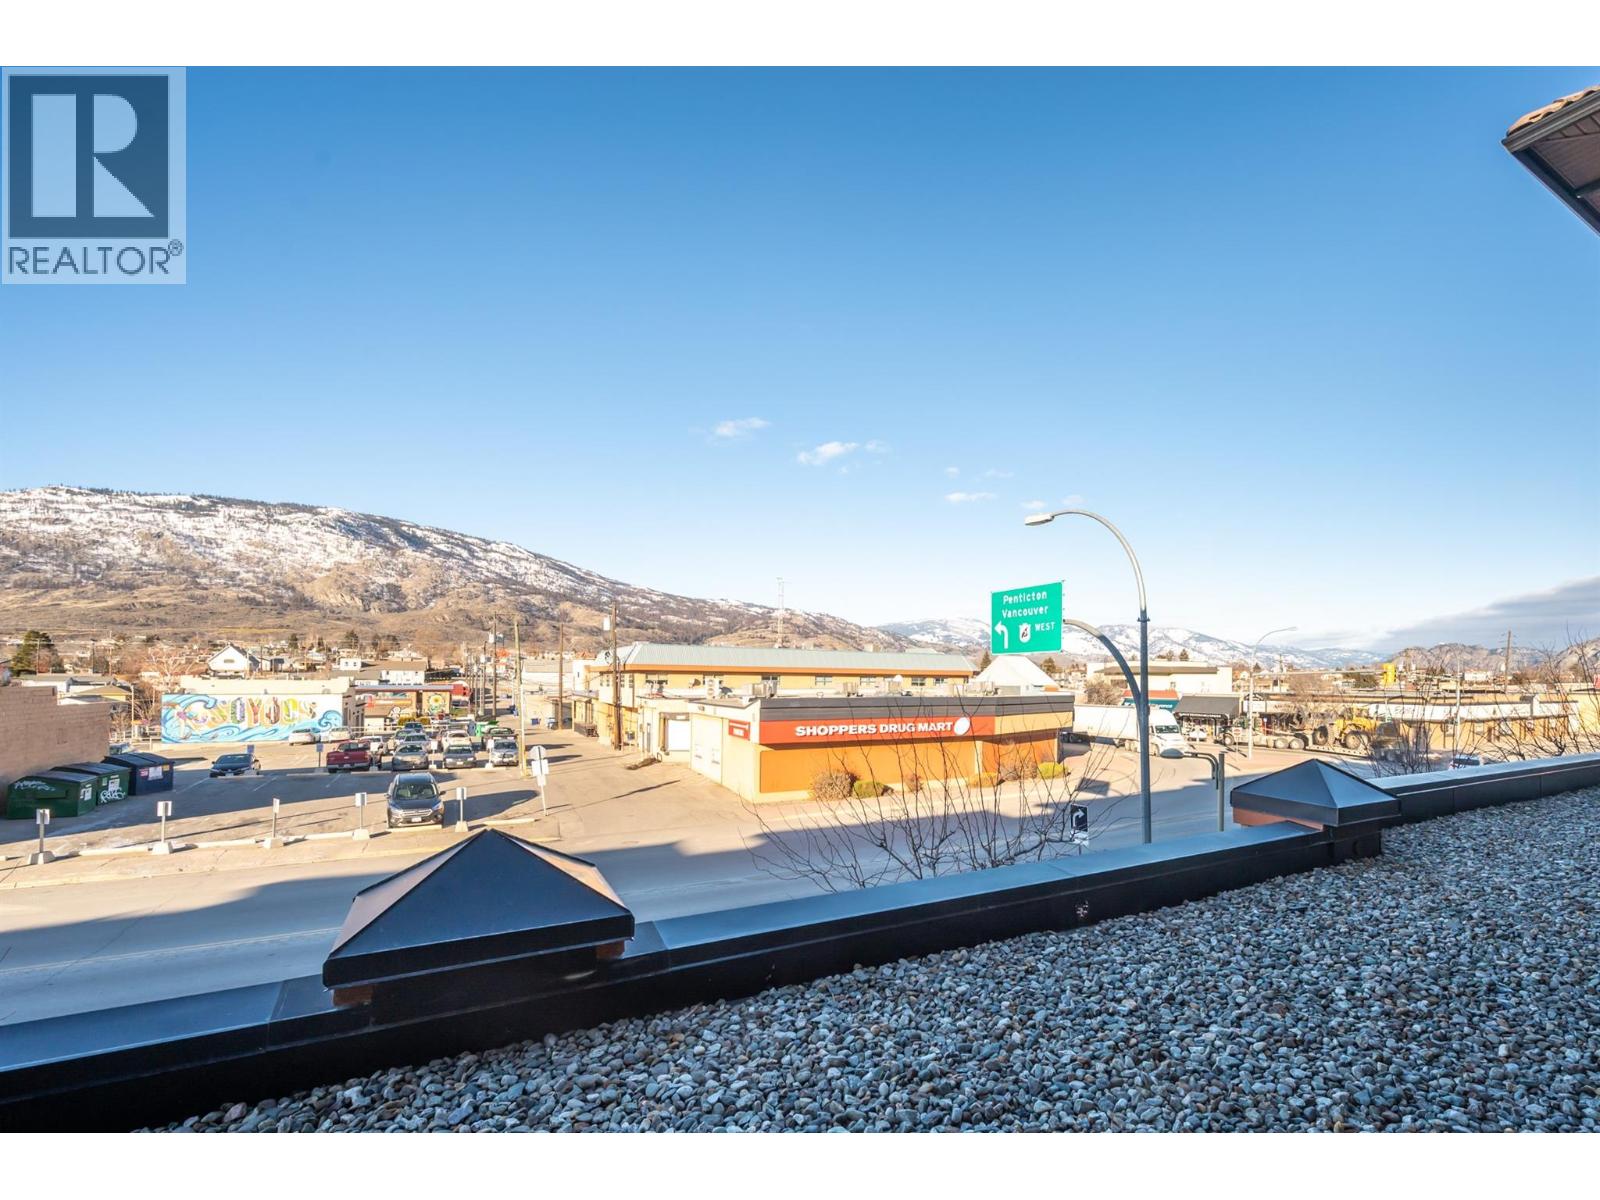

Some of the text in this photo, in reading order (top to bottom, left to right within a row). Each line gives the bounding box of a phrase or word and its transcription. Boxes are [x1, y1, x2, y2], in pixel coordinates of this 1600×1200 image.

[1003, 591, 1047, 604] Penticton
[1002, 606, 1048, 618] Vancouver
[1034, 621, 1055, 631] WEST
[795, 721, 953, 737] SHOPPERS DRUG MART
